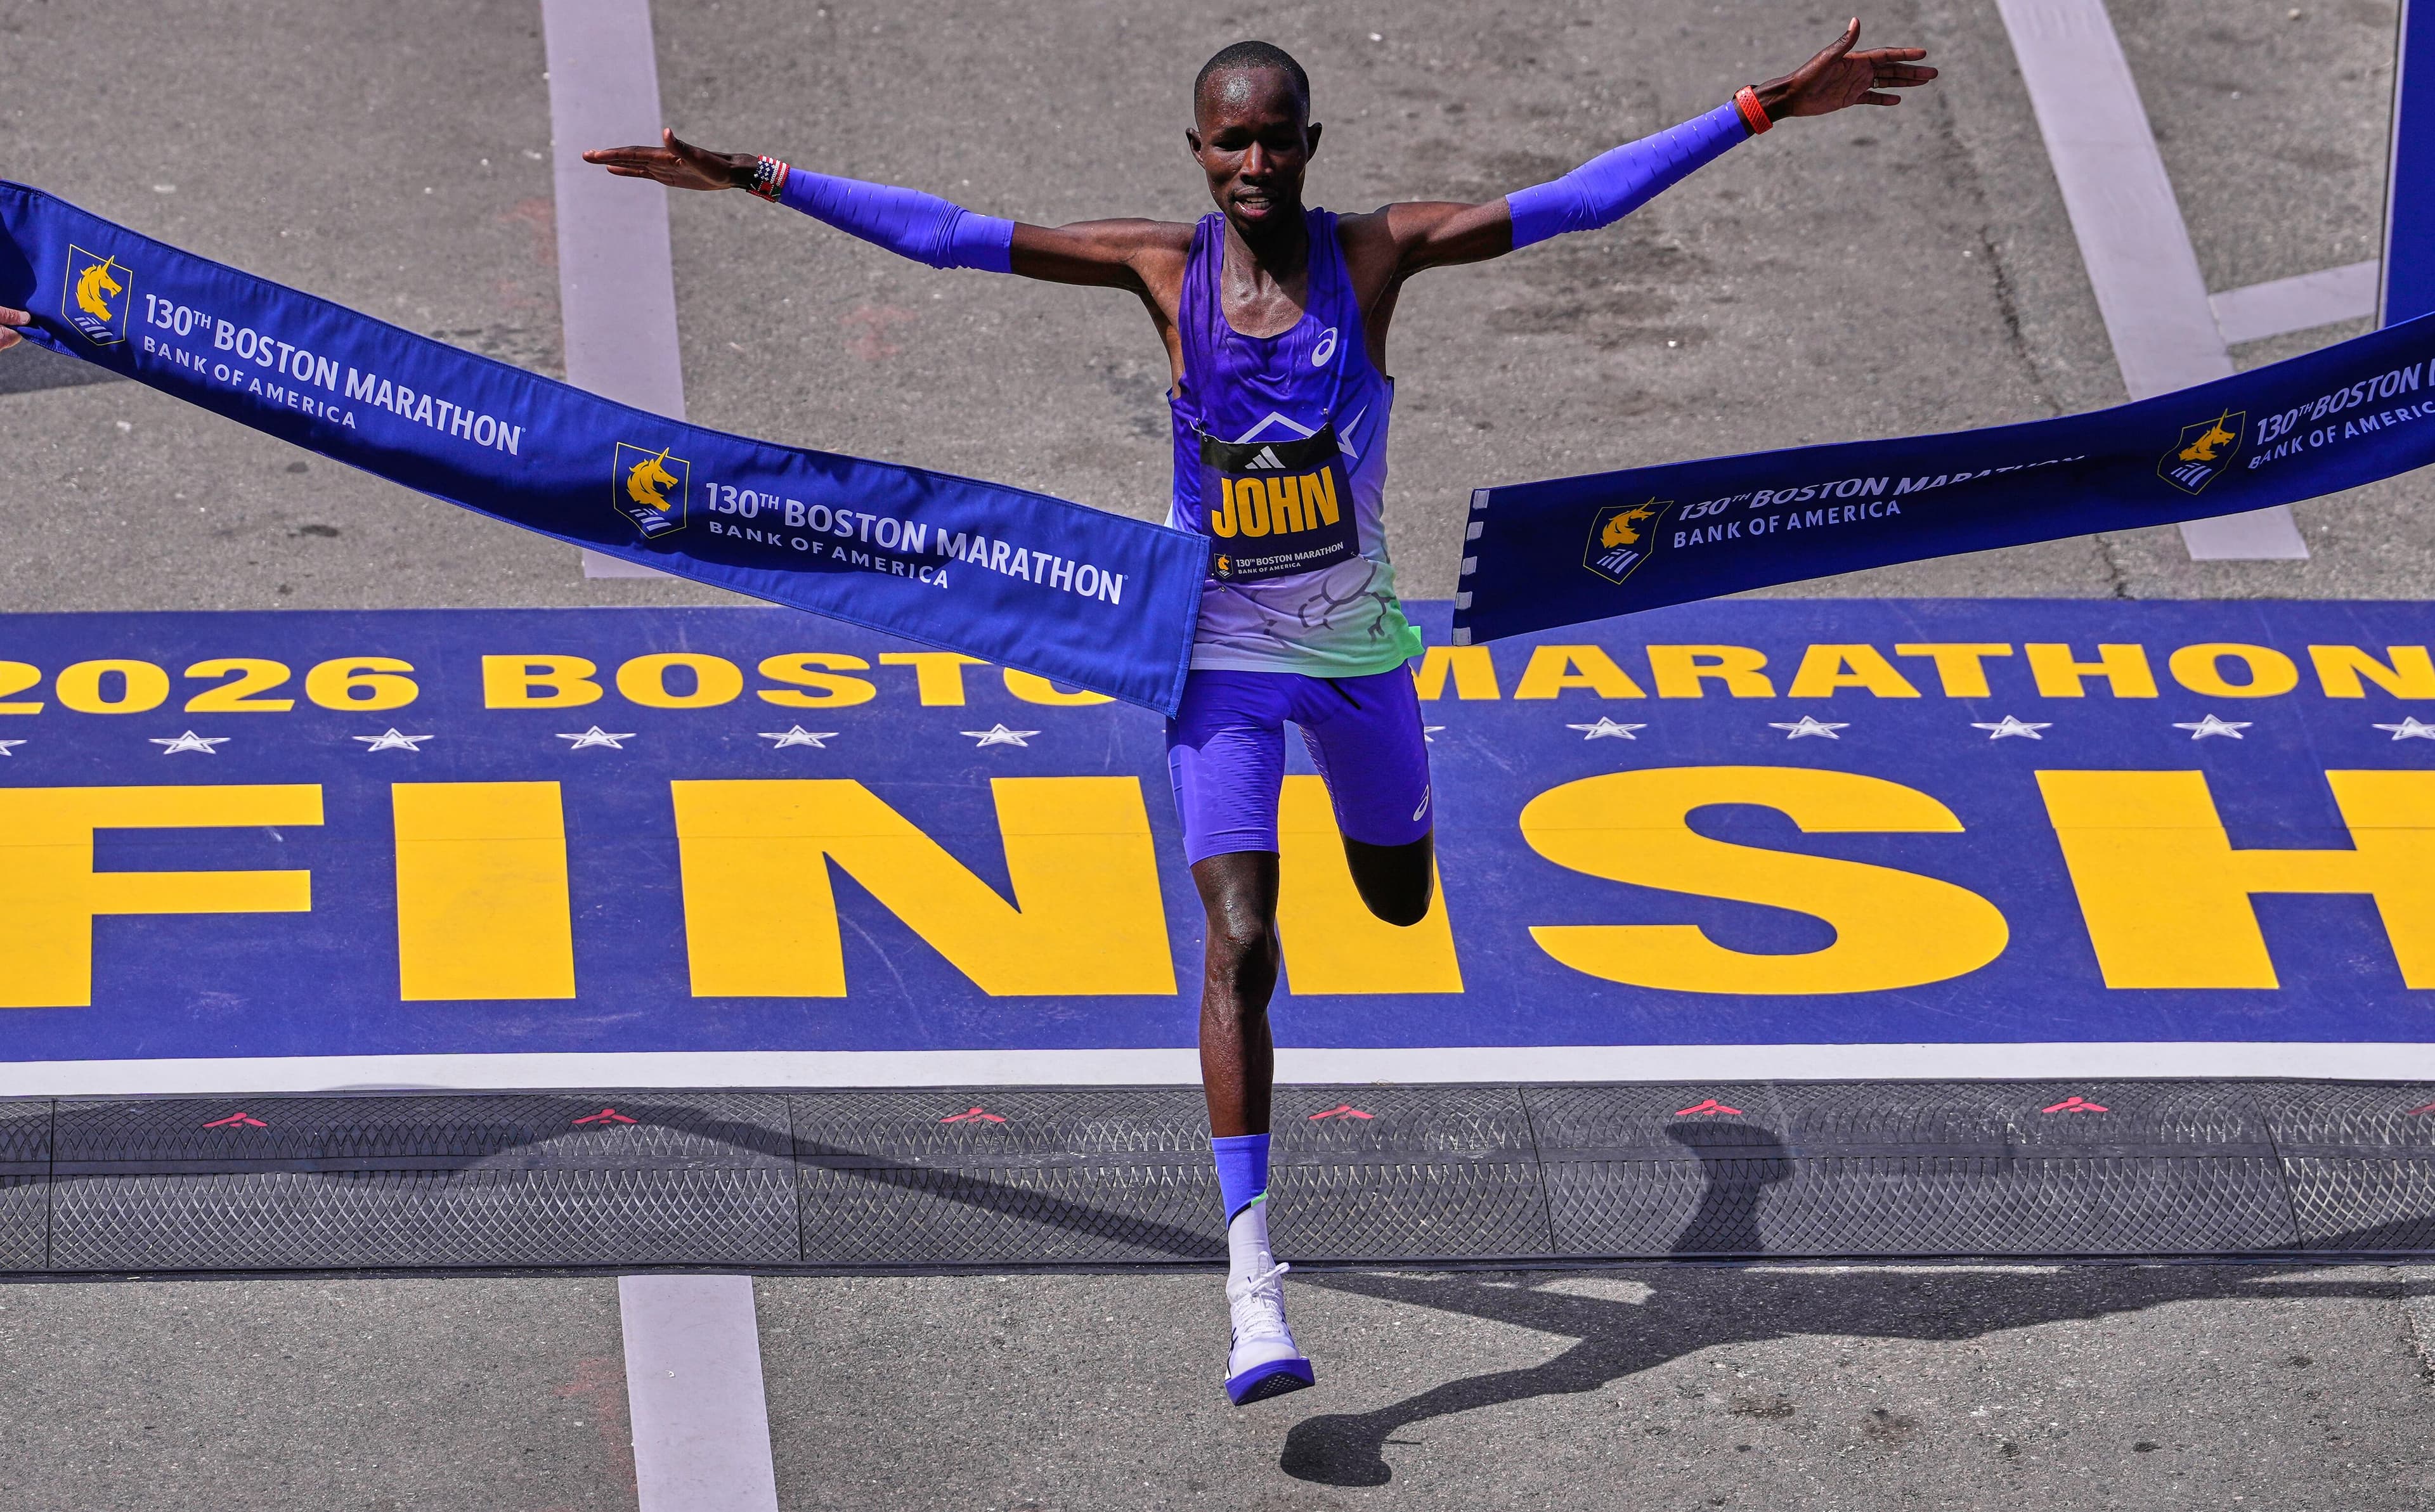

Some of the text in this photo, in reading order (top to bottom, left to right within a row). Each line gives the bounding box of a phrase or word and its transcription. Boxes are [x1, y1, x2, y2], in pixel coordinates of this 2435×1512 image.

[143, 335, 356, 430] BANK OF AMERICA
[145, 293, 522, 456] 130TH BOSTON MARATHON
[2256, 401, 2315, 446] 130TH
[2310, 362, 2422, 422] BOSTON
[2247, 400, 2435, 469] BANK OF AMERIC
[1211, 465, 1341, 538] JOHN
[1673, 500, 1902, 549] BANK OF AMERICA
[1678, 476, 1890, 522] 130TH BOSTON
[705, 482, 1124, 606] 130TH BOSTON MARATHON
[709, 520, 949, 590] BANK OF AMERICA
[1235, 541, 1344, 568] 130TH BOSTON MARATHON
[1269, 562, 1302, 571] AMERICA
[482, 653, 1117, 709] BOST
[0, 765, 2435, 1008] FINISH
